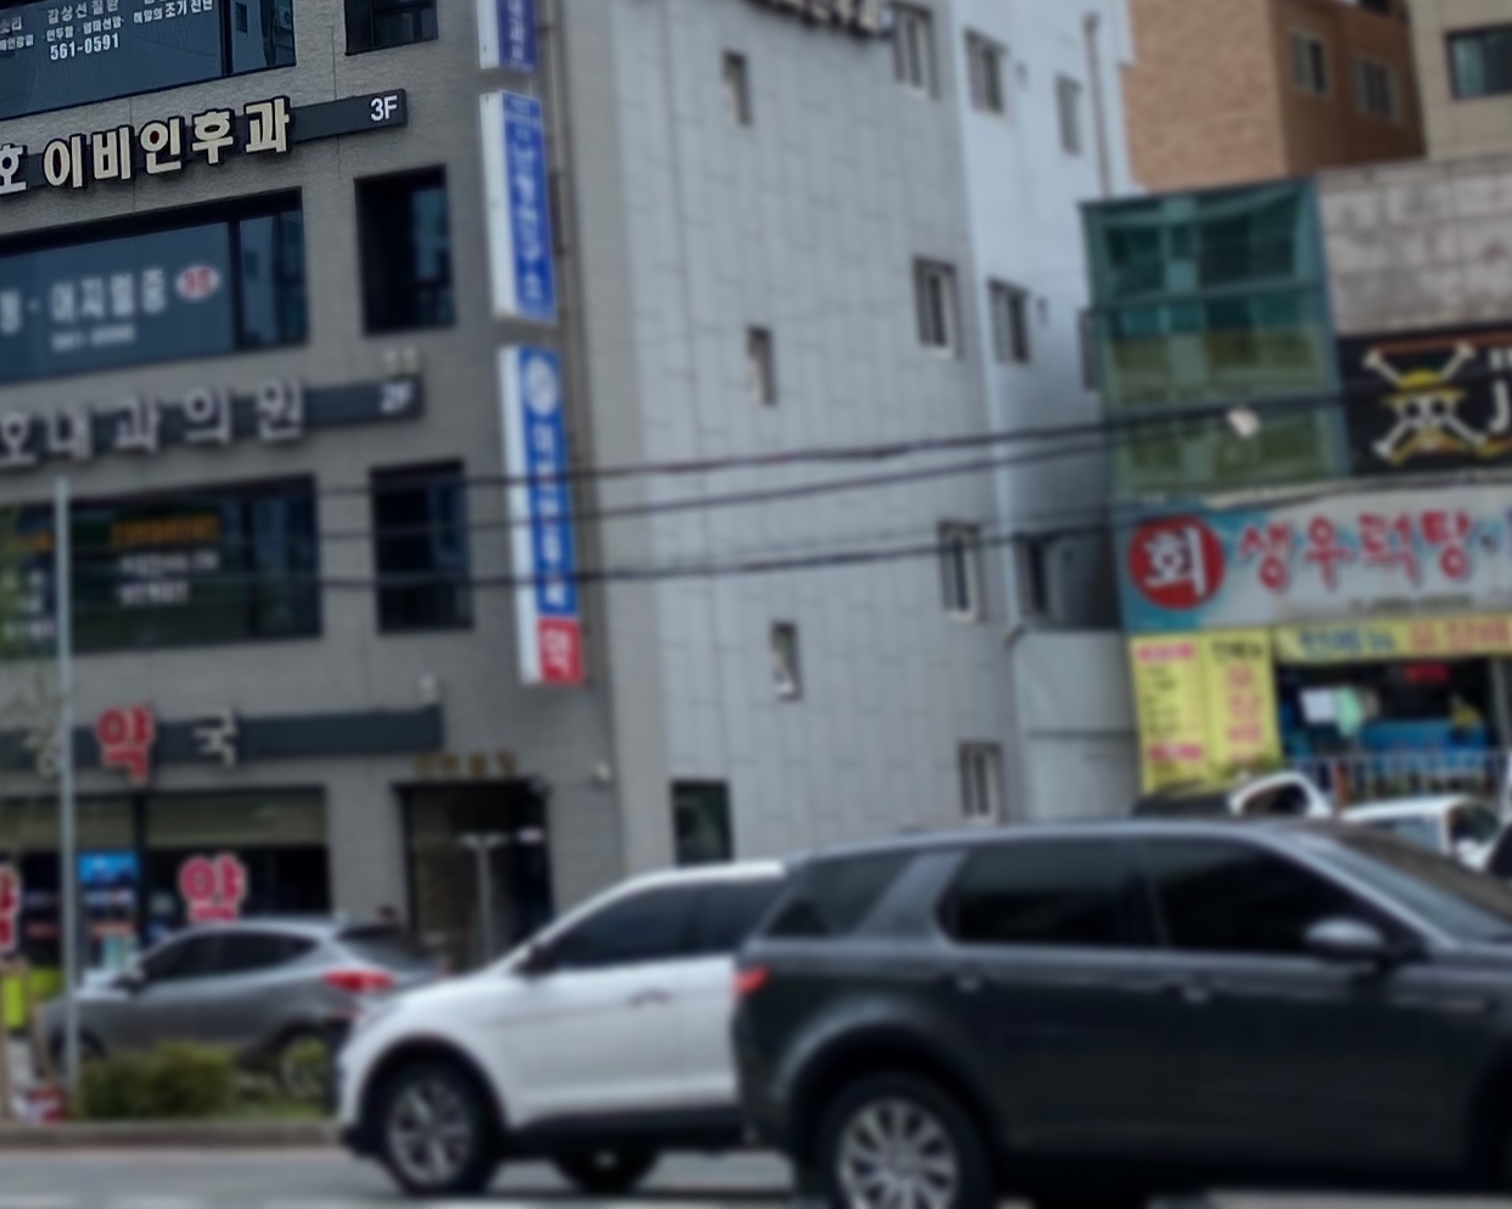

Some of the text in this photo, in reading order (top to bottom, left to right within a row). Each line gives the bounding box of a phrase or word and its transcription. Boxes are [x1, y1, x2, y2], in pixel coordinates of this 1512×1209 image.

[50, 33, 120, 61] 561-0591
[43, 94, 291, 190] 이비인후과
[369, 95, 400, 123] 3F
[1143, 526, 1207, 598] 회
